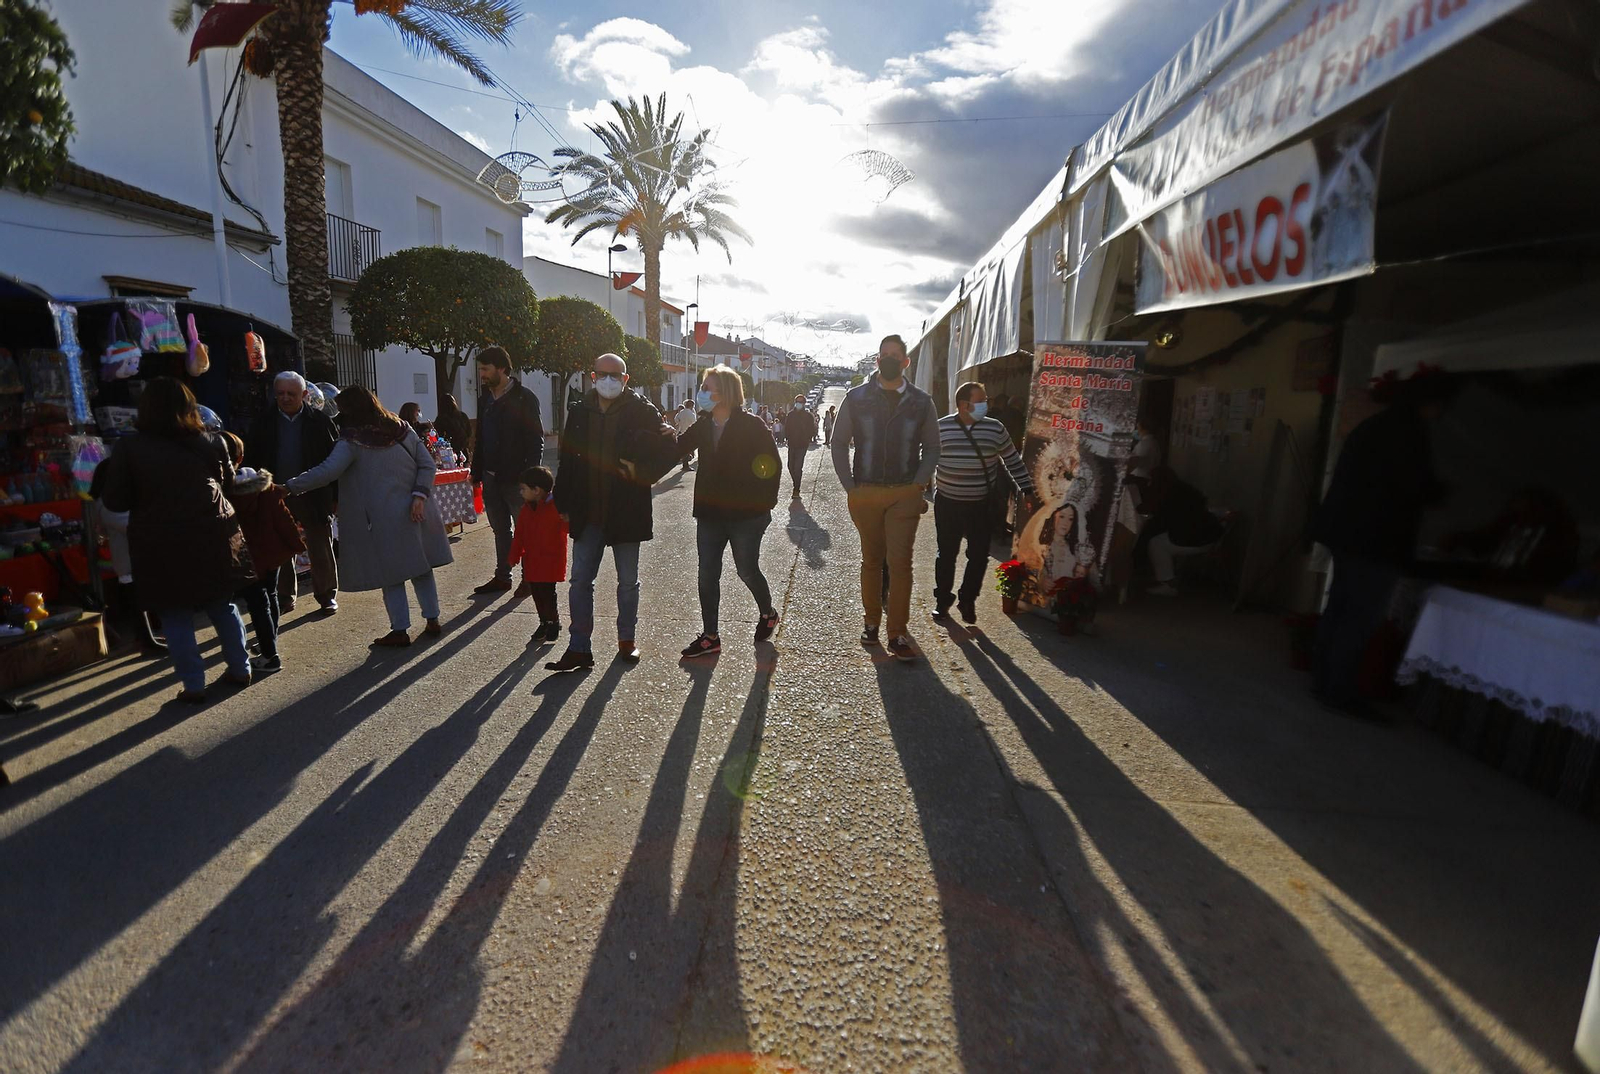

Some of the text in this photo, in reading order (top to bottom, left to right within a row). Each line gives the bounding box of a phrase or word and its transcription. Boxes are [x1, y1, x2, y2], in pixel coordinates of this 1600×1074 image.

[1043, 353, 1136, 370] Hermandad
[1039, 371, 1133, 391] Santa María
[1071, 395, 1089, 409] de
[1051, 414, 1104, 433] España
